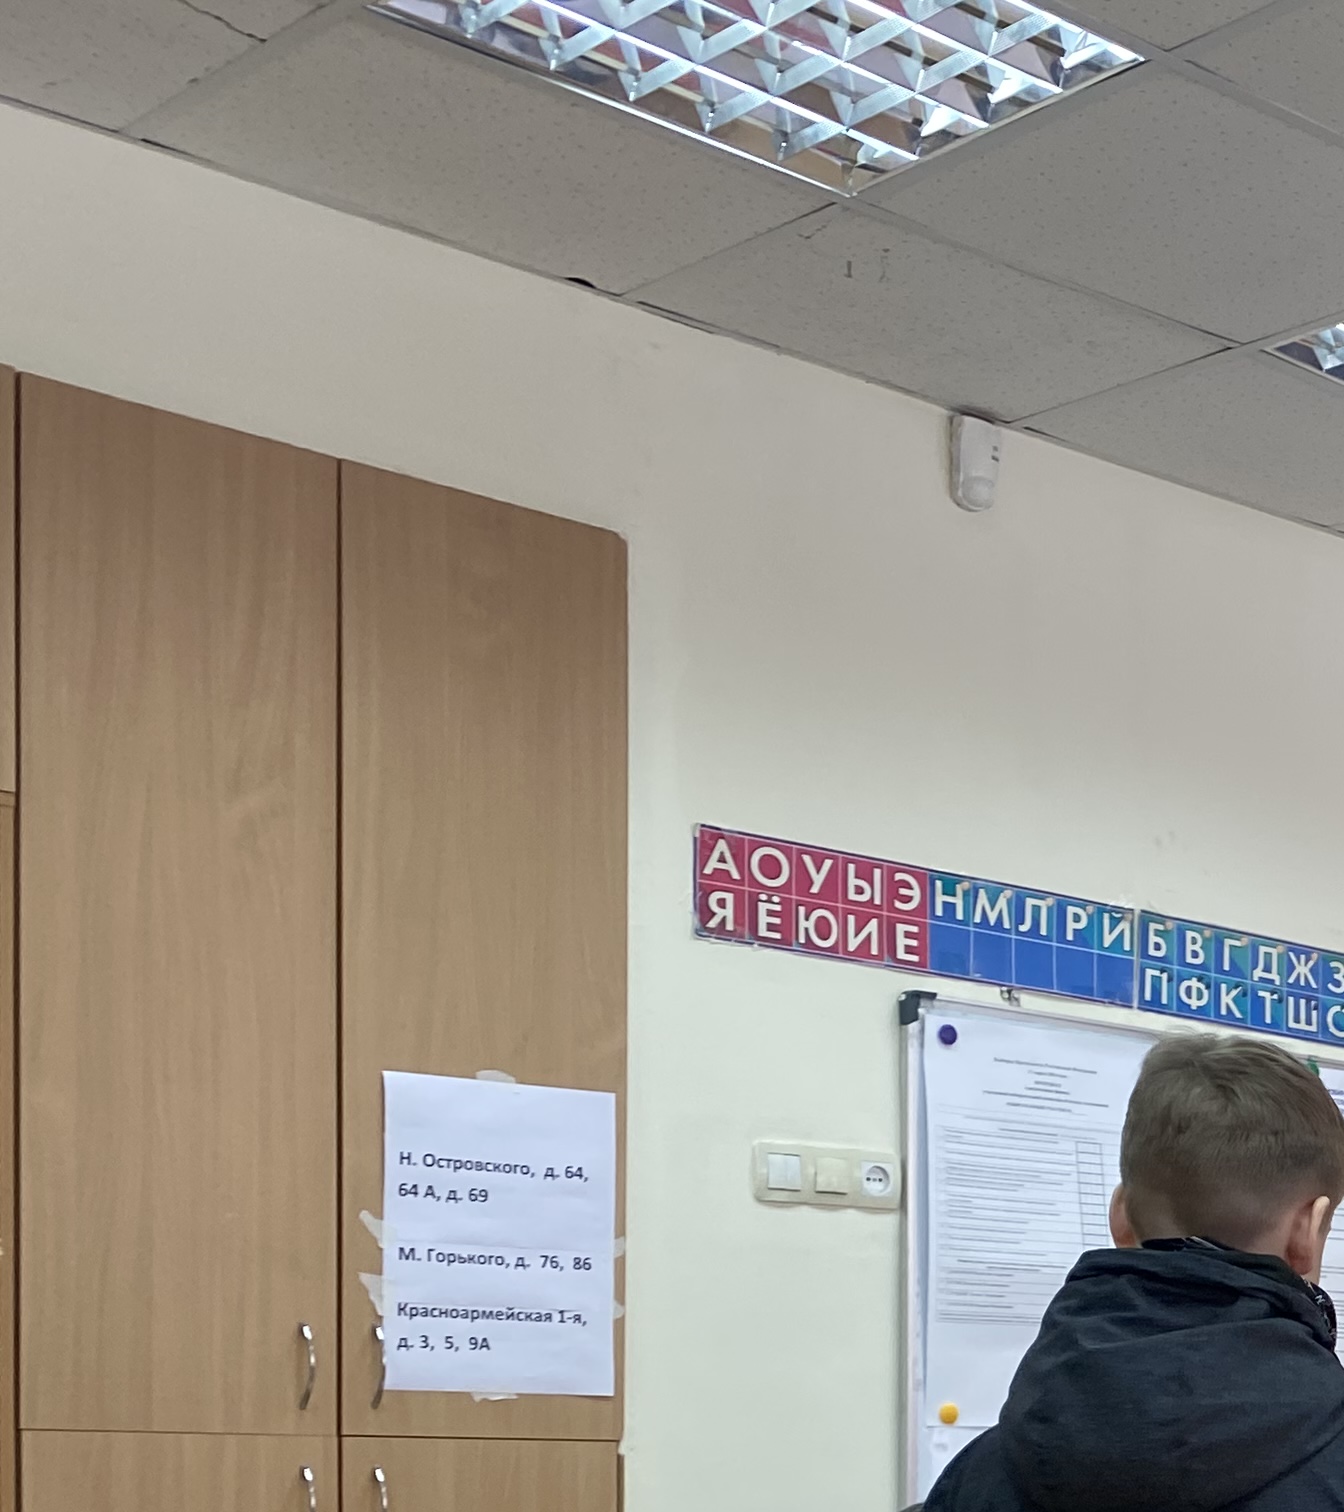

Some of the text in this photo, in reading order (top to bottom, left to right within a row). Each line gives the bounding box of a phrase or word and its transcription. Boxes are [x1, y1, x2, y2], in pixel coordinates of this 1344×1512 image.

[400, 1152, 589, 1182] Н. Островского, д. 64,
[398, 1183, 488, 1204] 64 А, д. 69
[399, 1247, 592, 1272] М. Горького, д. 76, 86
[397, 1302, 588, 1327] Красноармейская 1-я,
[397, 1335, 491, 1352] д. 3, 5, 9А
